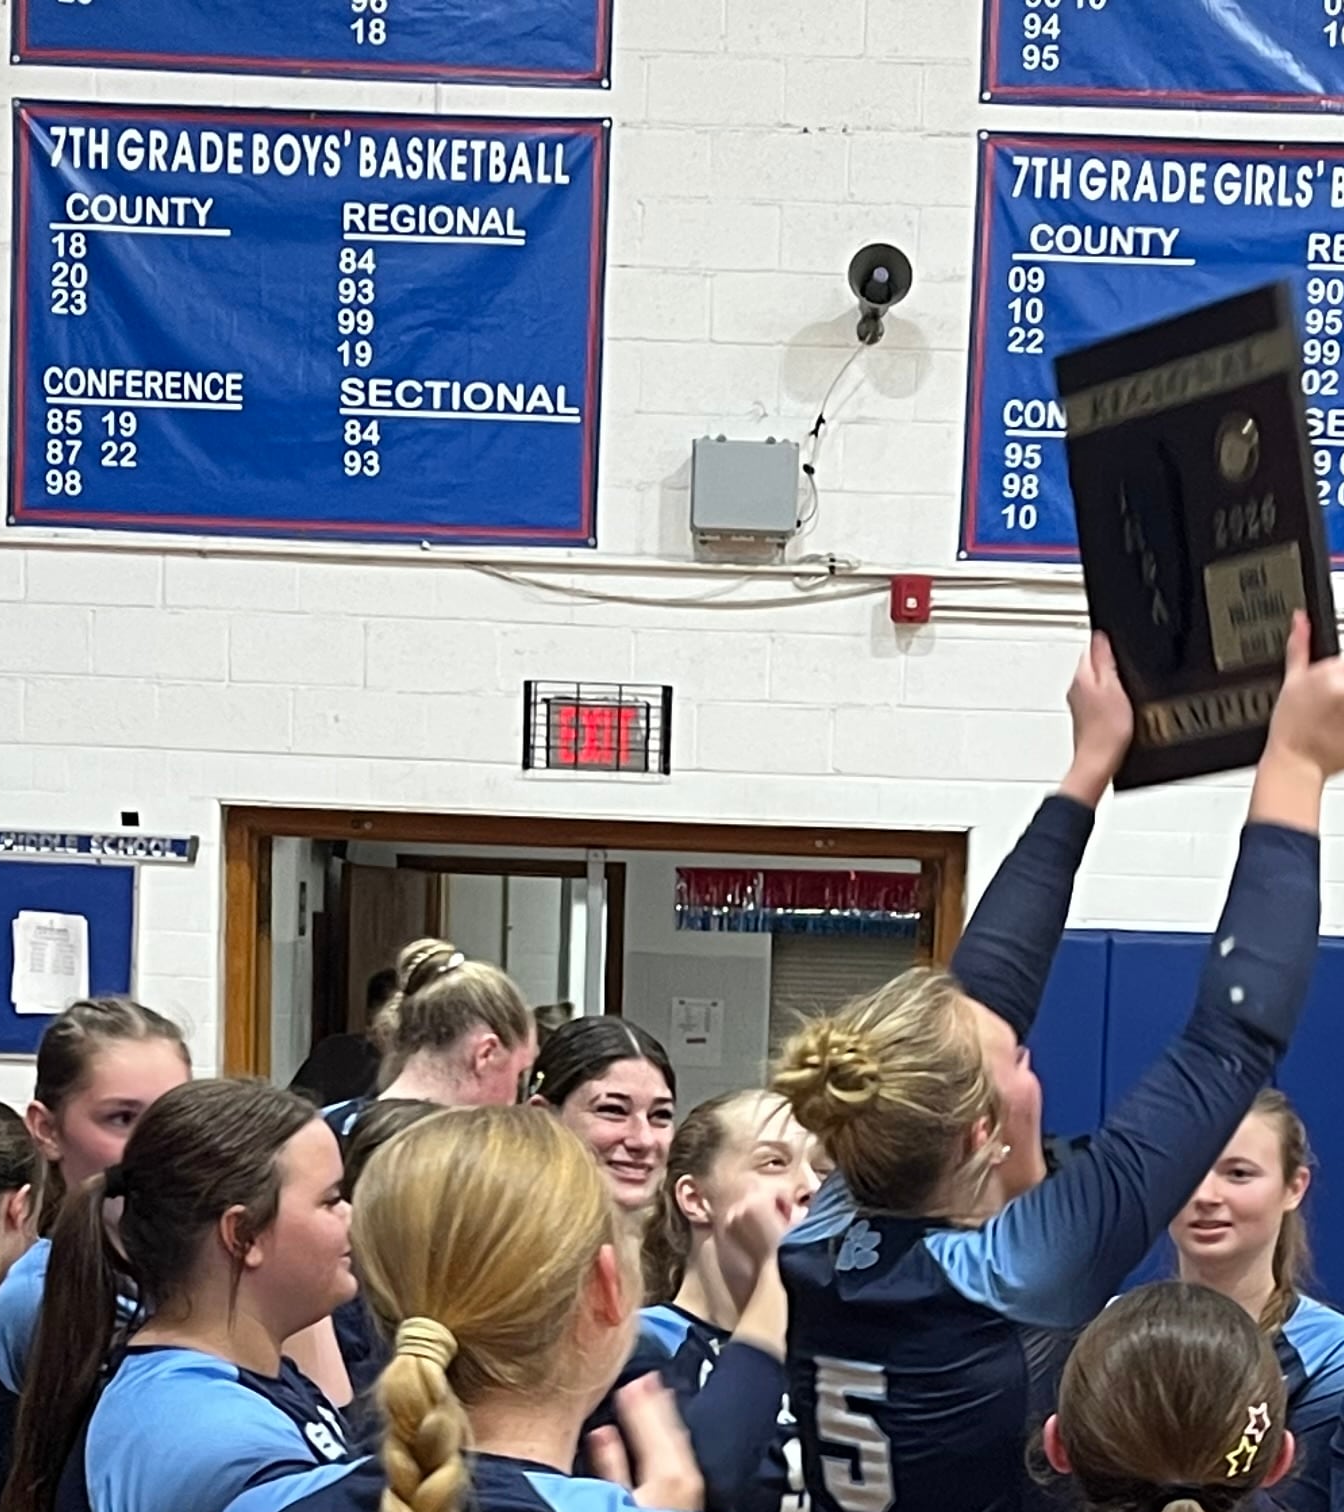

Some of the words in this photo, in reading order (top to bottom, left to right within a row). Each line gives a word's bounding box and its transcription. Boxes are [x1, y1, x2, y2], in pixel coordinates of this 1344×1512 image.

[350, 17, 387, 45] 18
[1023, 12, 1061, 40] 94
[1022, 43, 1060, 72] 95
[44, 126, 109, 175] 7TH
[117, 128, 244, 174] GRADE
[252, 129, 351, 178] BOYS'
[359, 136, 570, 185] BASKETBALL
[1011, 155, 1072, 200] 7TH
[1079, 158, 1207, 204] GRADE
[1213, 159, 1325, 209] GIRLS'
[65, 191, 214, 228] COUNTY
[343, 202, 525, 236] REGIONAL
[51, 231, 87, 259] 18
[1029, 223, 1180, 257] COUNTY
[338, 247, 377, 275] 84
[50, 262, 88, 289] 20
[1008, 266, 1045, 294] 09
[50, 289, 88, 316] 23
[338, 277, 375, 305] 93
[1306, 277, 1344, 305] 90
[337, 308, 374, 335] 99
[1007, 297, 1044, 324] 10
[1305, 308, 1343, 336] 95
[337, 340, 373, 368] 19
[1007, 326, 1045, 354] 22
[1303, 338, 1341, 366] 99
[43, 366, 244, 402] CONFERENCE
[1301, 368, 1339, 396] 02
[340, 378, 582, 415] SECTIONAL
[46, 408, 83, 435] 85
[101, 410, 137, 437] 19
[1003, 399, 1068, 429] CON
[344, 419, 381, 446] 84
[46, 438, 83, 466] 87
[101, 440, 137, 468] 22
[343, 449, 380, 477] 93
[1004, 442, 1042, 470] 95
[1313, 449, 1332, 476] 9
[45, 469, 82, 496] 98
[1002, 472, 1039, 500] 98
[1316, 480, 1332, 506] 2
[1001, 503, 1037, 530] 10
[559, 706, 635, 764] EXIT
